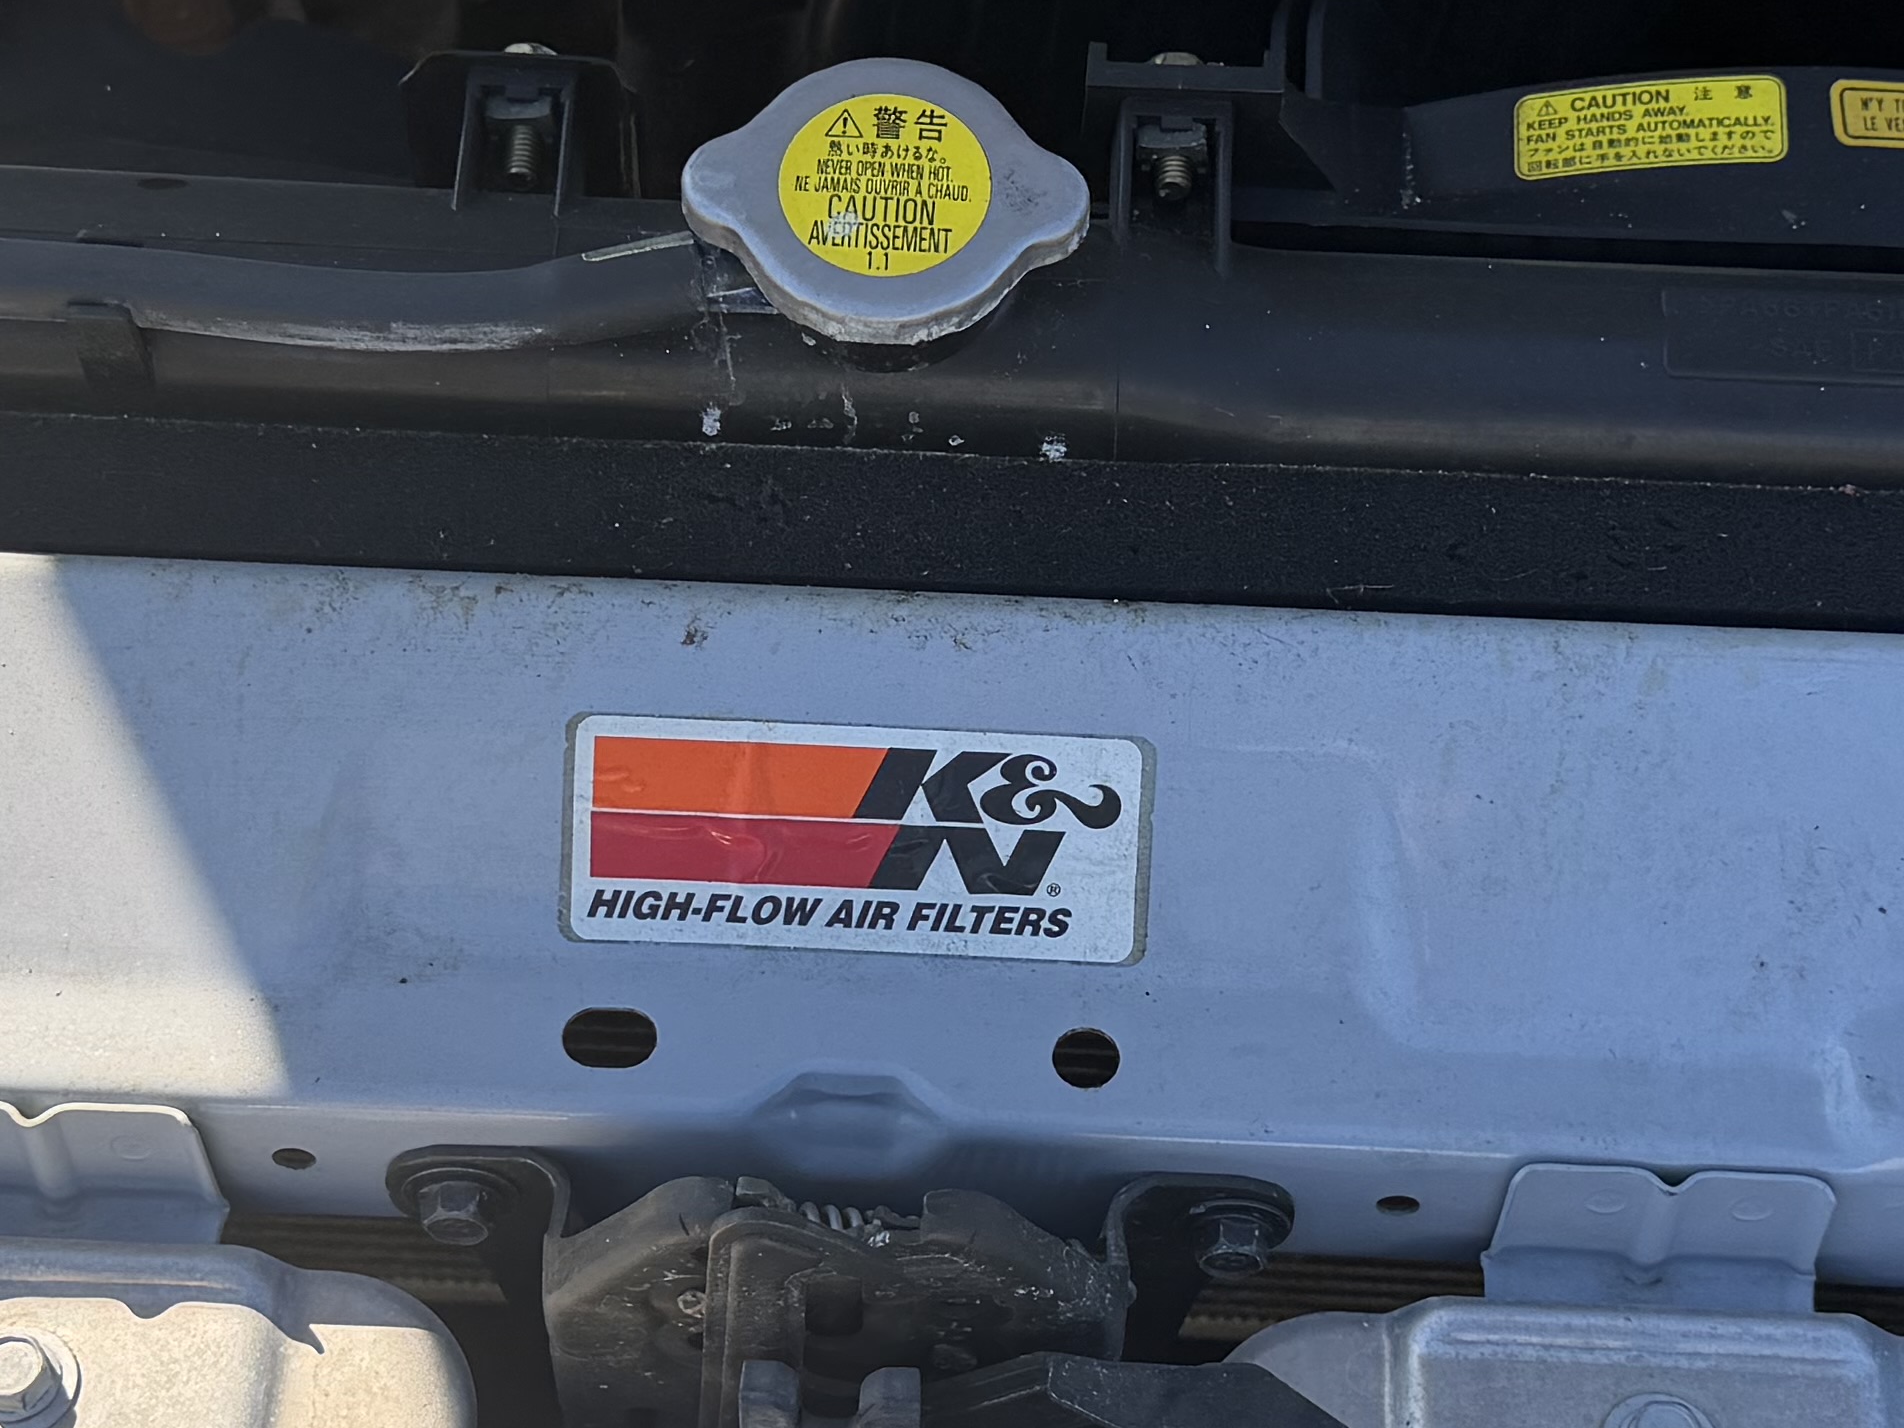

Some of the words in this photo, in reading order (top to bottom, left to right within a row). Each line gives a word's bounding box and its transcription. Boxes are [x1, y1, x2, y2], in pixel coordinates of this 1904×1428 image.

[1570, 89, 1670, 113] CAUTION
[873, 106, 948, 143] 警告
[1526, 116, 1569, 132] KEEP
[1576, 109, 1634, 126] HANDS
[1863, 115, 1878, 132] LE
[1526, 131, 1557, 147] FAN
[1565, 124, 1628, 142] STARTS
[827, 139, 947, 165] 熱い時あけるな。
[817, 158, 852, 177] NEVER
[856, 160, 886, 178] OPEN
[890, 162, 924, 181] WHEN
[928, 165, 954, 183] HOT.
[795, 175, 810, 193] NE
[814, 176, 861, 195] JAMAIS
[865, 178, 911, 197] OUVRIR
[927, 183, 973, 203] CHAUD.
[827, 193, 937, 226] CAUTION
[808, 219, 953, 255] AVERTISSEMENT
[866, 250, 890, 272] 1.1
[587, 889, 823, 929] HIGH-FLOW
[825, 898, 901, 932] AIR
[906, 903, 1074, 939] FILTERS
